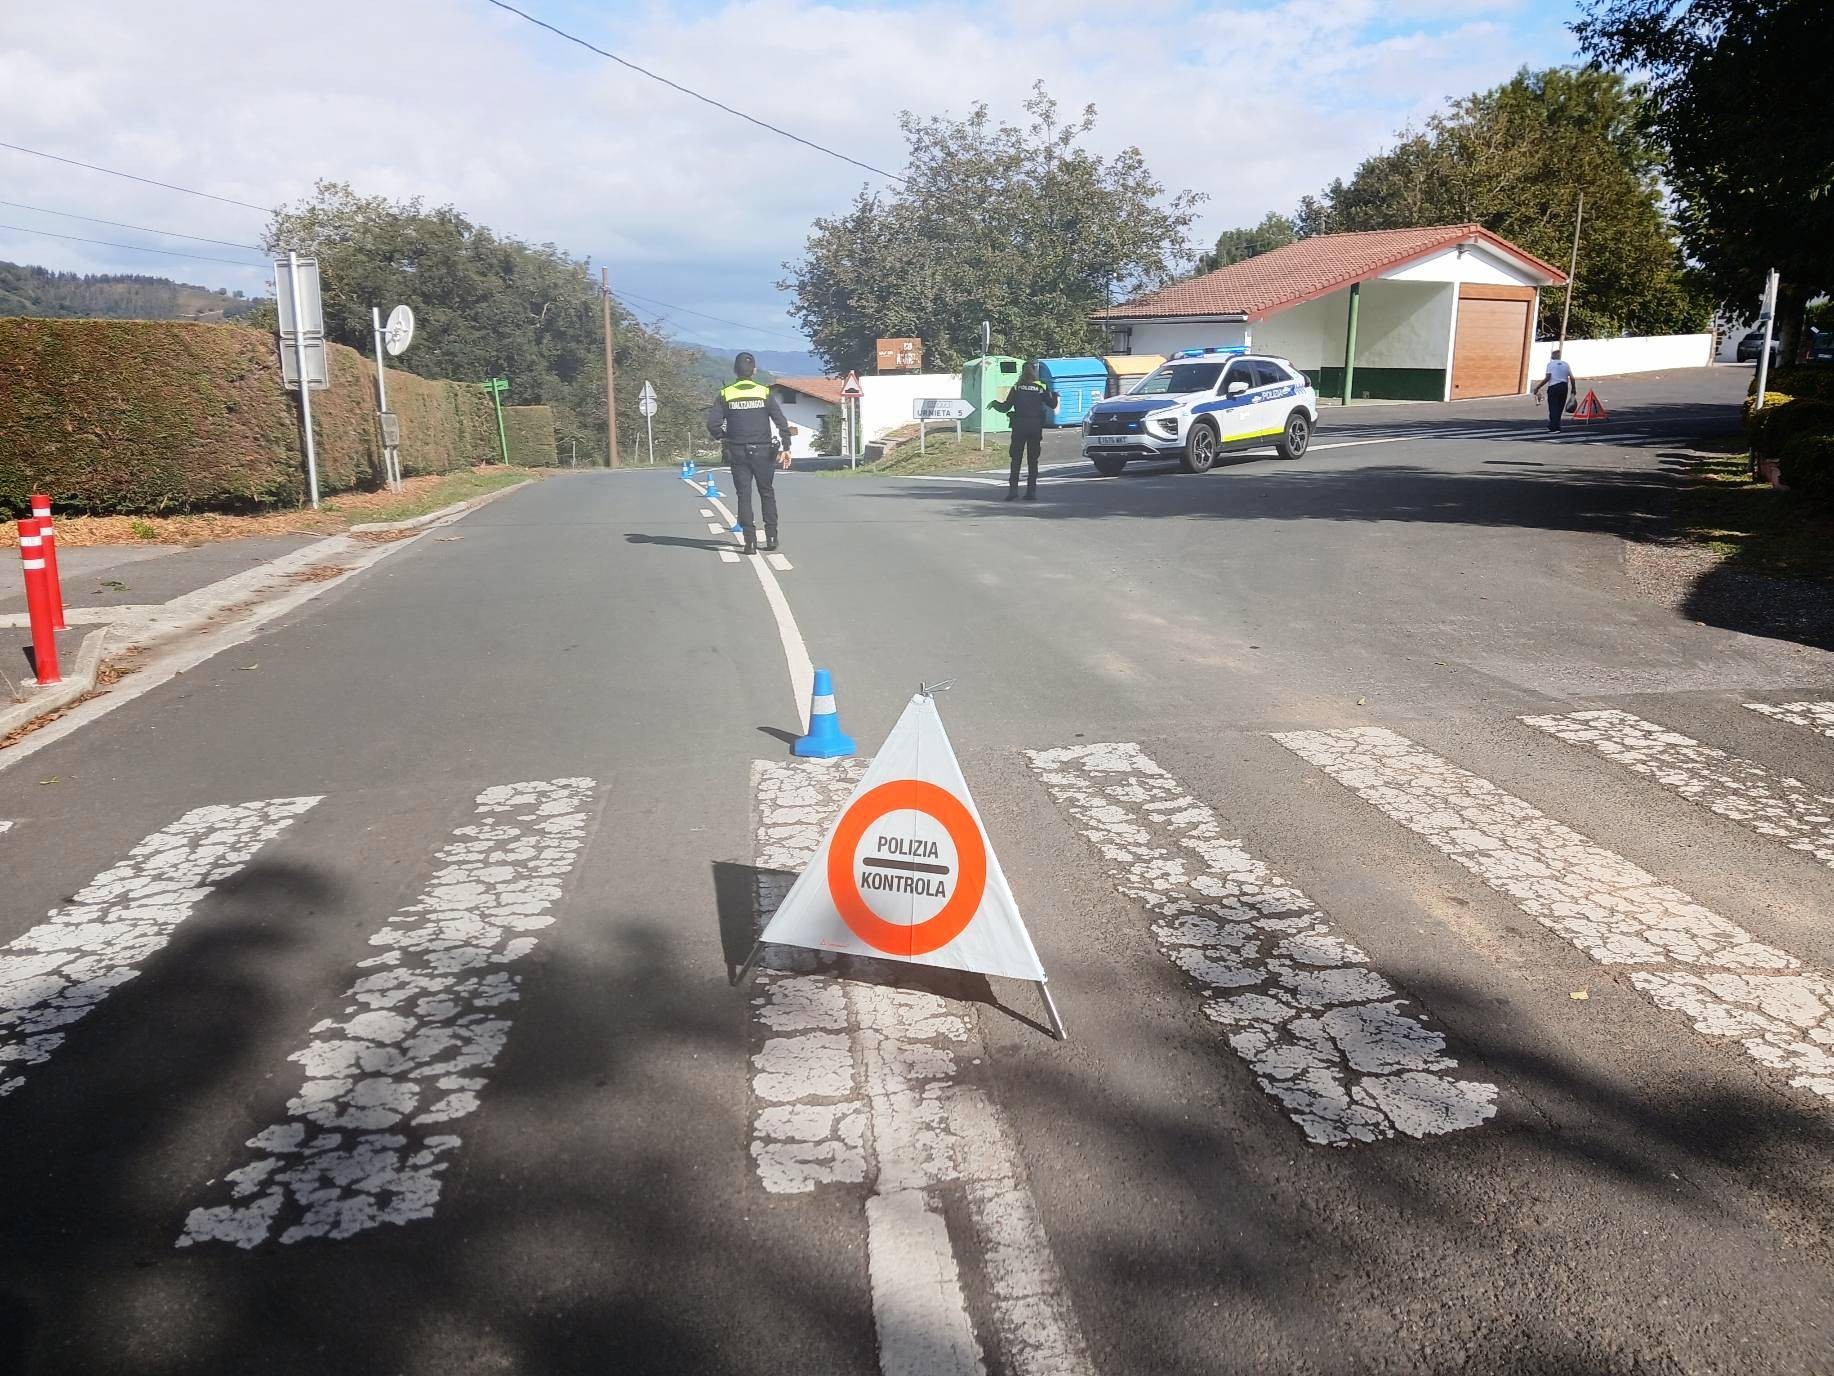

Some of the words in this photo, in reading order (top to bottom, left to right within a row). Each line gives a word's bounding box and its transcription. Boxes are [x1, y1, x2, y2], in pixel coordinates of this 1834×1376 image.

[917, 409, 951, 417] URNIETA
[957, 409, 963, 417] 5
[877, 836, 939, 859] POLIZIA
[860, 871, 946, 898] KONTROLA
